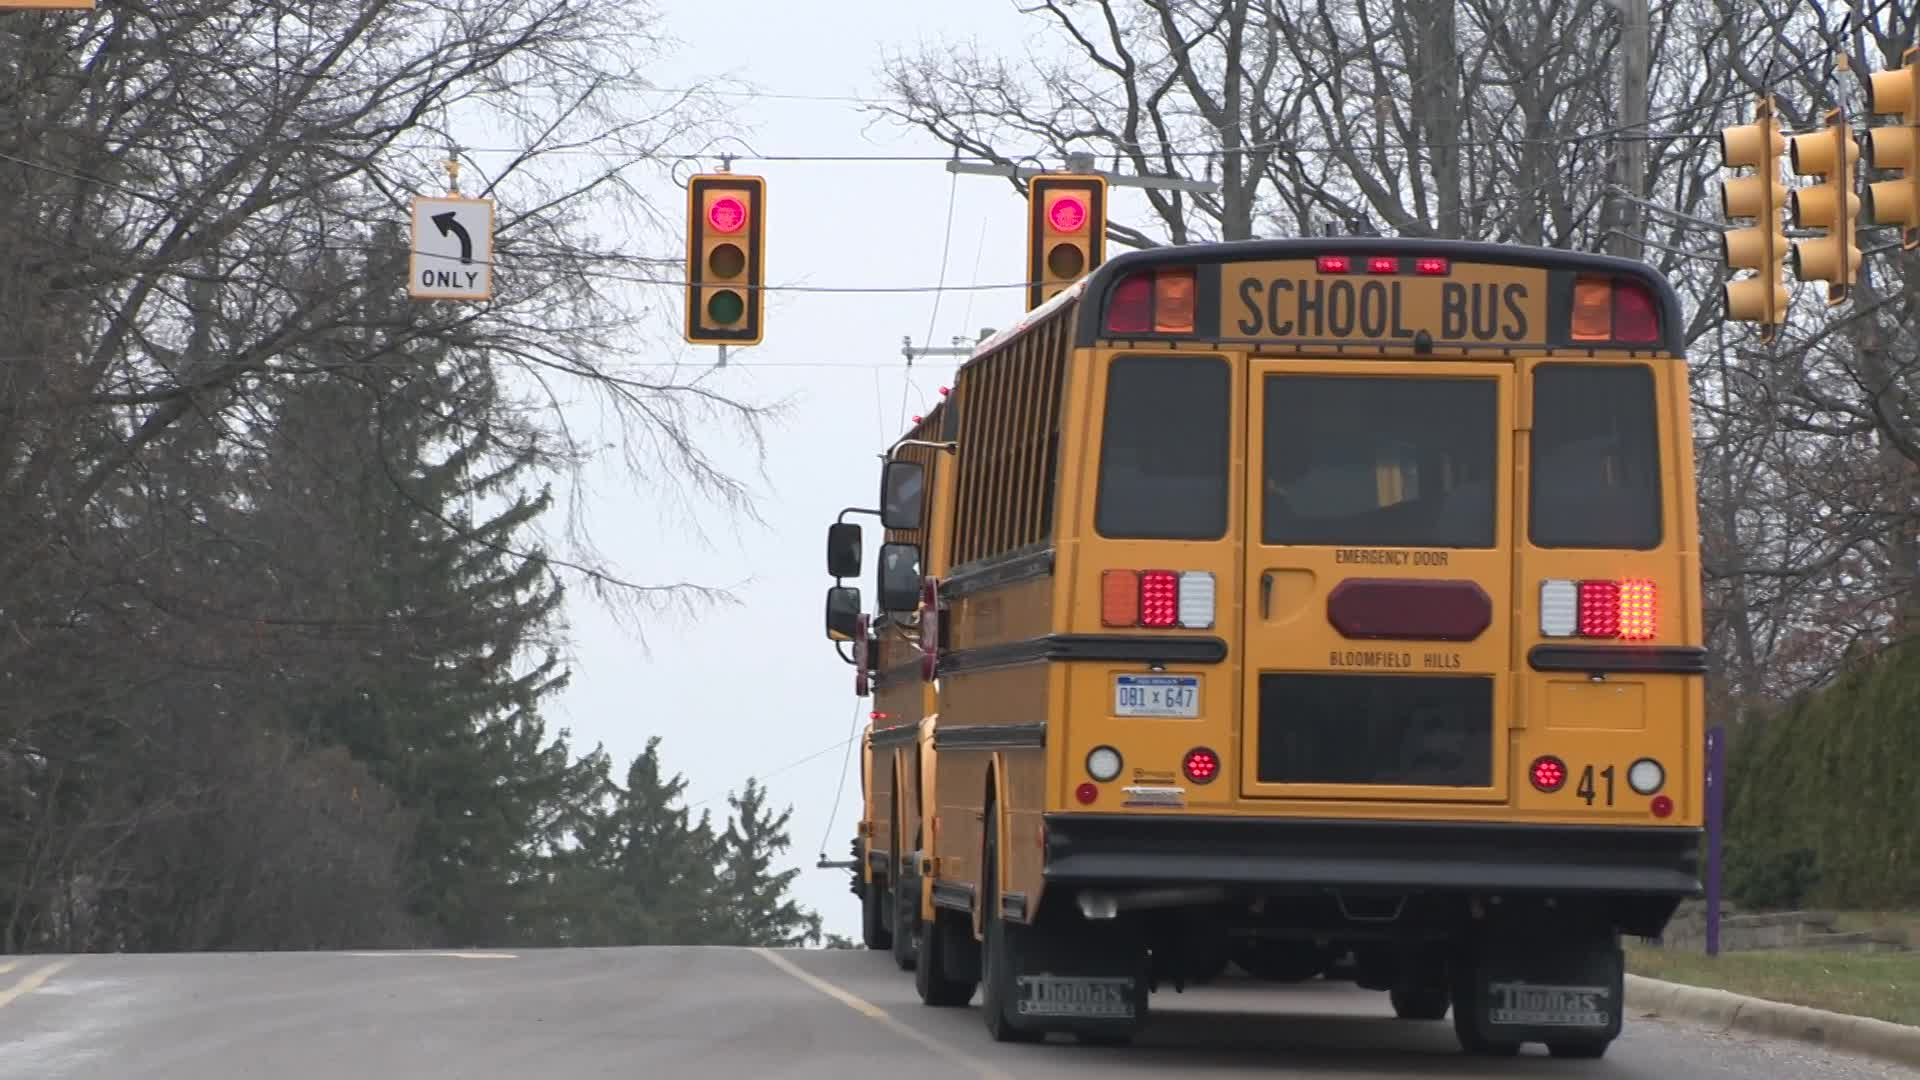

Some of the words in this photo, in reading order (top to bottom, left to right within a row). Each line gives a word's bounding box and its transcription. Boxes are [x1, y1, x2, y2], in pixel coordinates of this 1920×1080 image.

[422, 269, 478, 289] ONLY
[1238, 278, 1414, 337] SCHOOL
[1442, 282, 1528, 341] BUS
[1336, 550, 1409, 565] EMERGENCY
[1413, 552, 1449, 567] DOOR
[1330, 651, 1411, 667] BLOOMFIELD
[1424, 654, 1462, 669] HILLS
[1166, 687, 1194, 708] 647
[1576, 764, 1614, 806] 41
